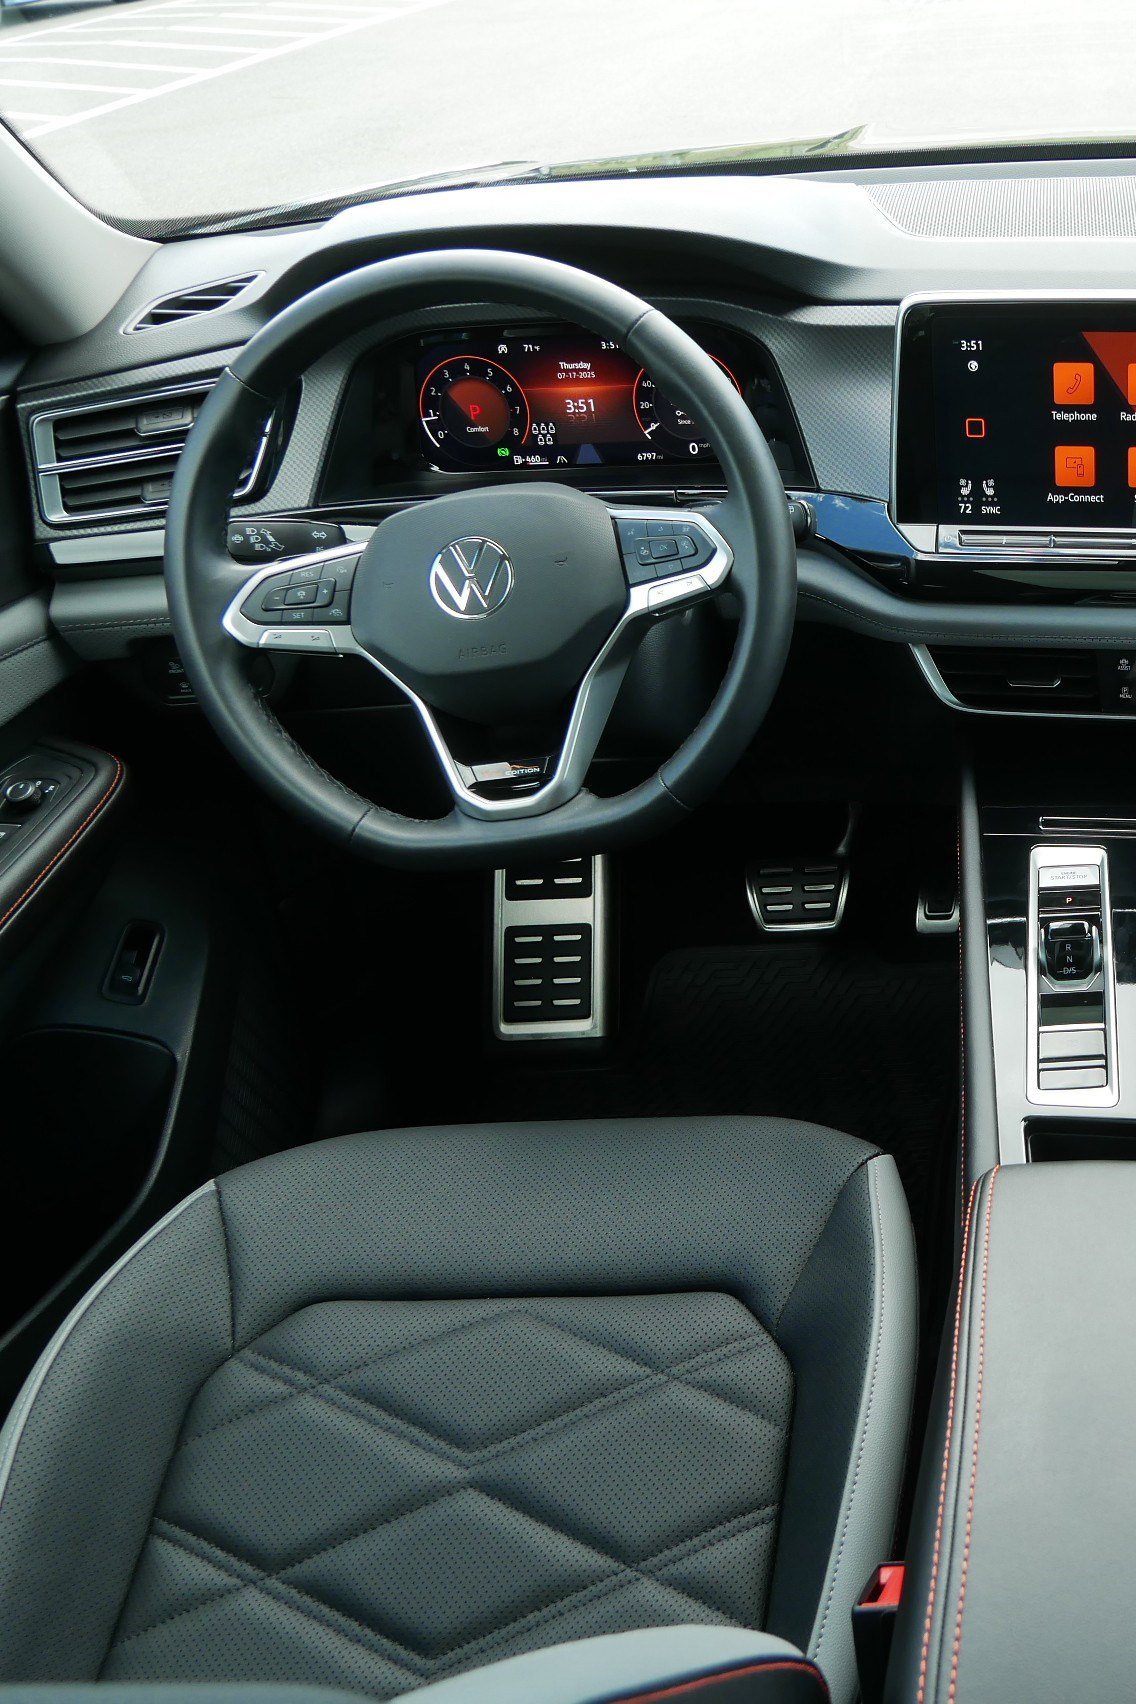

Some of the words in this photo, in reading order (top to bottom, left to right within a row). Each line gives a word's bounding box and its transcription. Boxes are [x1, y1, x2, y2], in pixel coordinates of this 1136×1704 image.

[523, 344, 533, 352] 71
[960, 340, 982, 350] 3:51
[464, 363, 470, 371] 4
[559, 362, 591, 370] Thursday
[444, 370, 450, 378] 3
[487, 368, 493, 376] 5
[558, 372, 596, 380] 07-17-2025
[506, 384, 513, 392] 6
[642, 380, 652, 388] 40
[430, 388, 436, 396] 2
[565, 398, 595, 412] 3:51
[470, 404, 480, 420] P
[515, 406, 520, 414] 7
[1051, 410, 1098, 422] Telephone
[438, 430, 444, 439] 0
[513, 428, 519, 436] 8
[689, 442, 699, 454] 0
[638, 452, 656, 460] 6797
[1046, 492, 1104, 504] App-Connect
[958, 503, 972, 514] 72
[981, 506, 1001, 514] SYNC
[458, 643, 508, 660] AIRBAG
